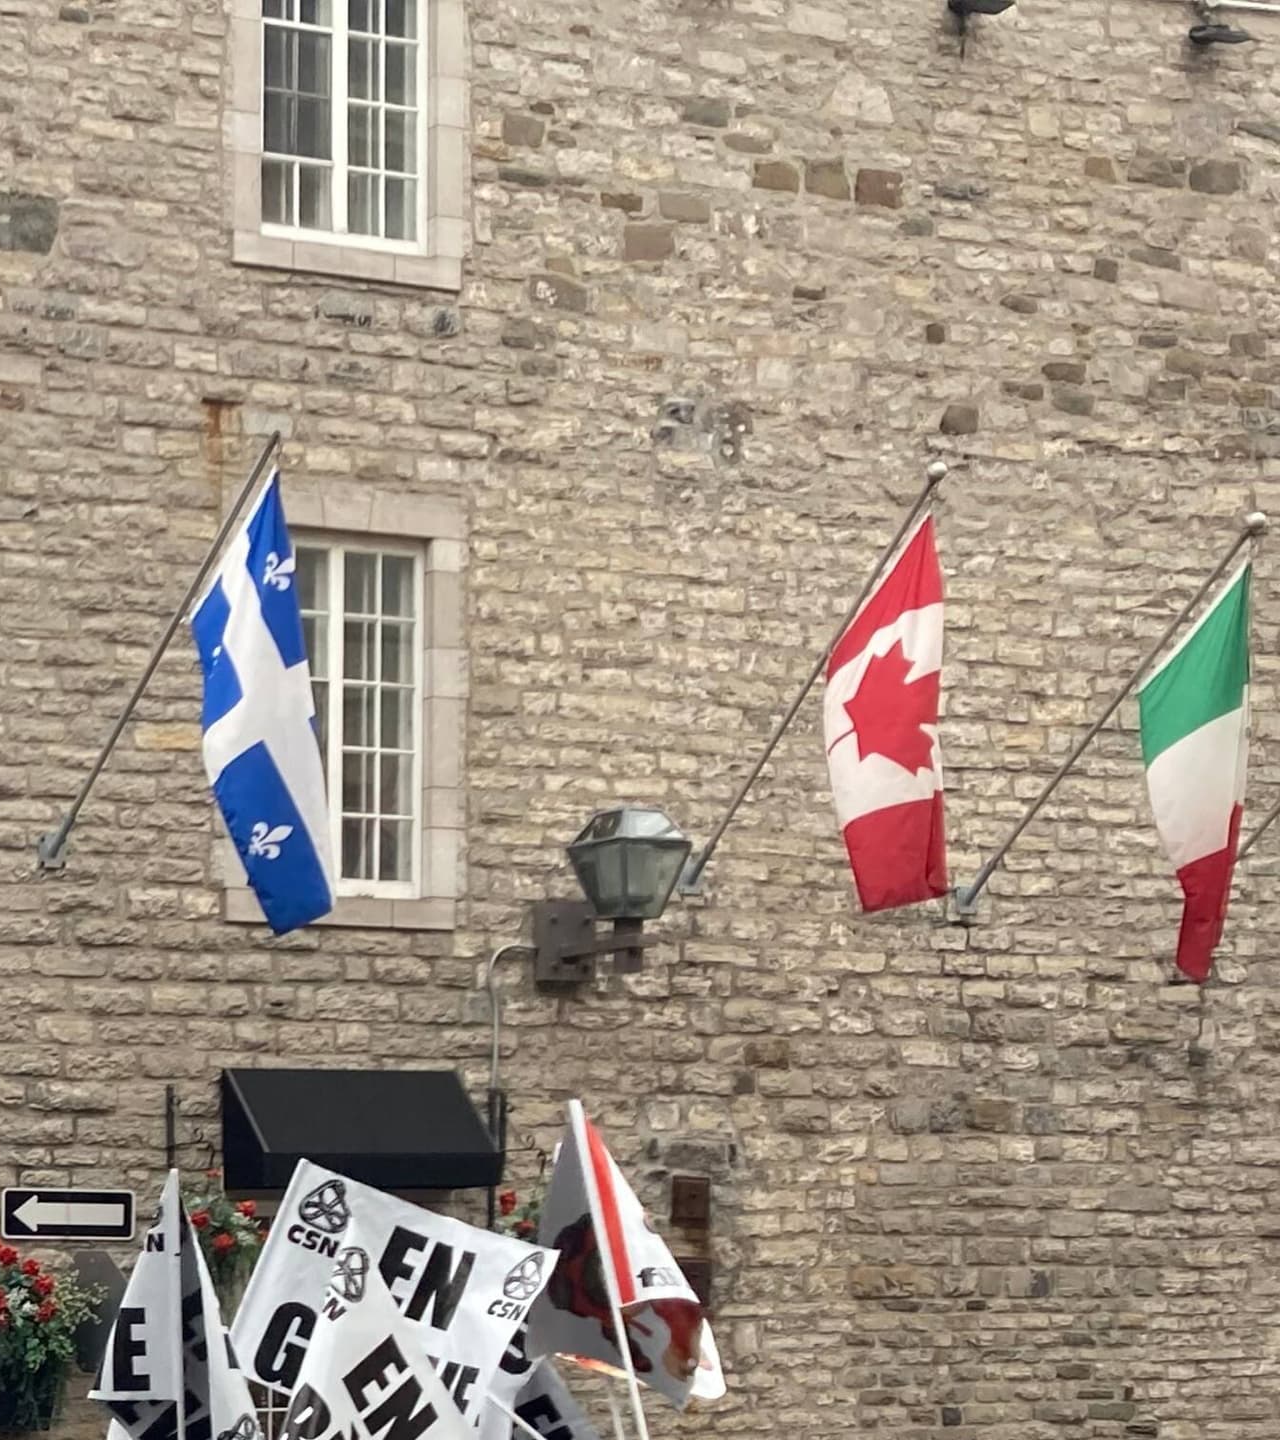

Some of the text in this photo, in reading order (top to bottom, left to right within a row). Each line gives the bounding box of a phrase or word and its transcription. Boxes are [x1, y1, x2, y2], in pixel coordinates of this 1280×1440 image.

[287, 1224, 340, 1259] CSN
[378, 1225, 476, 1331] EN
[486, 1298, 526, 1322] CSN
